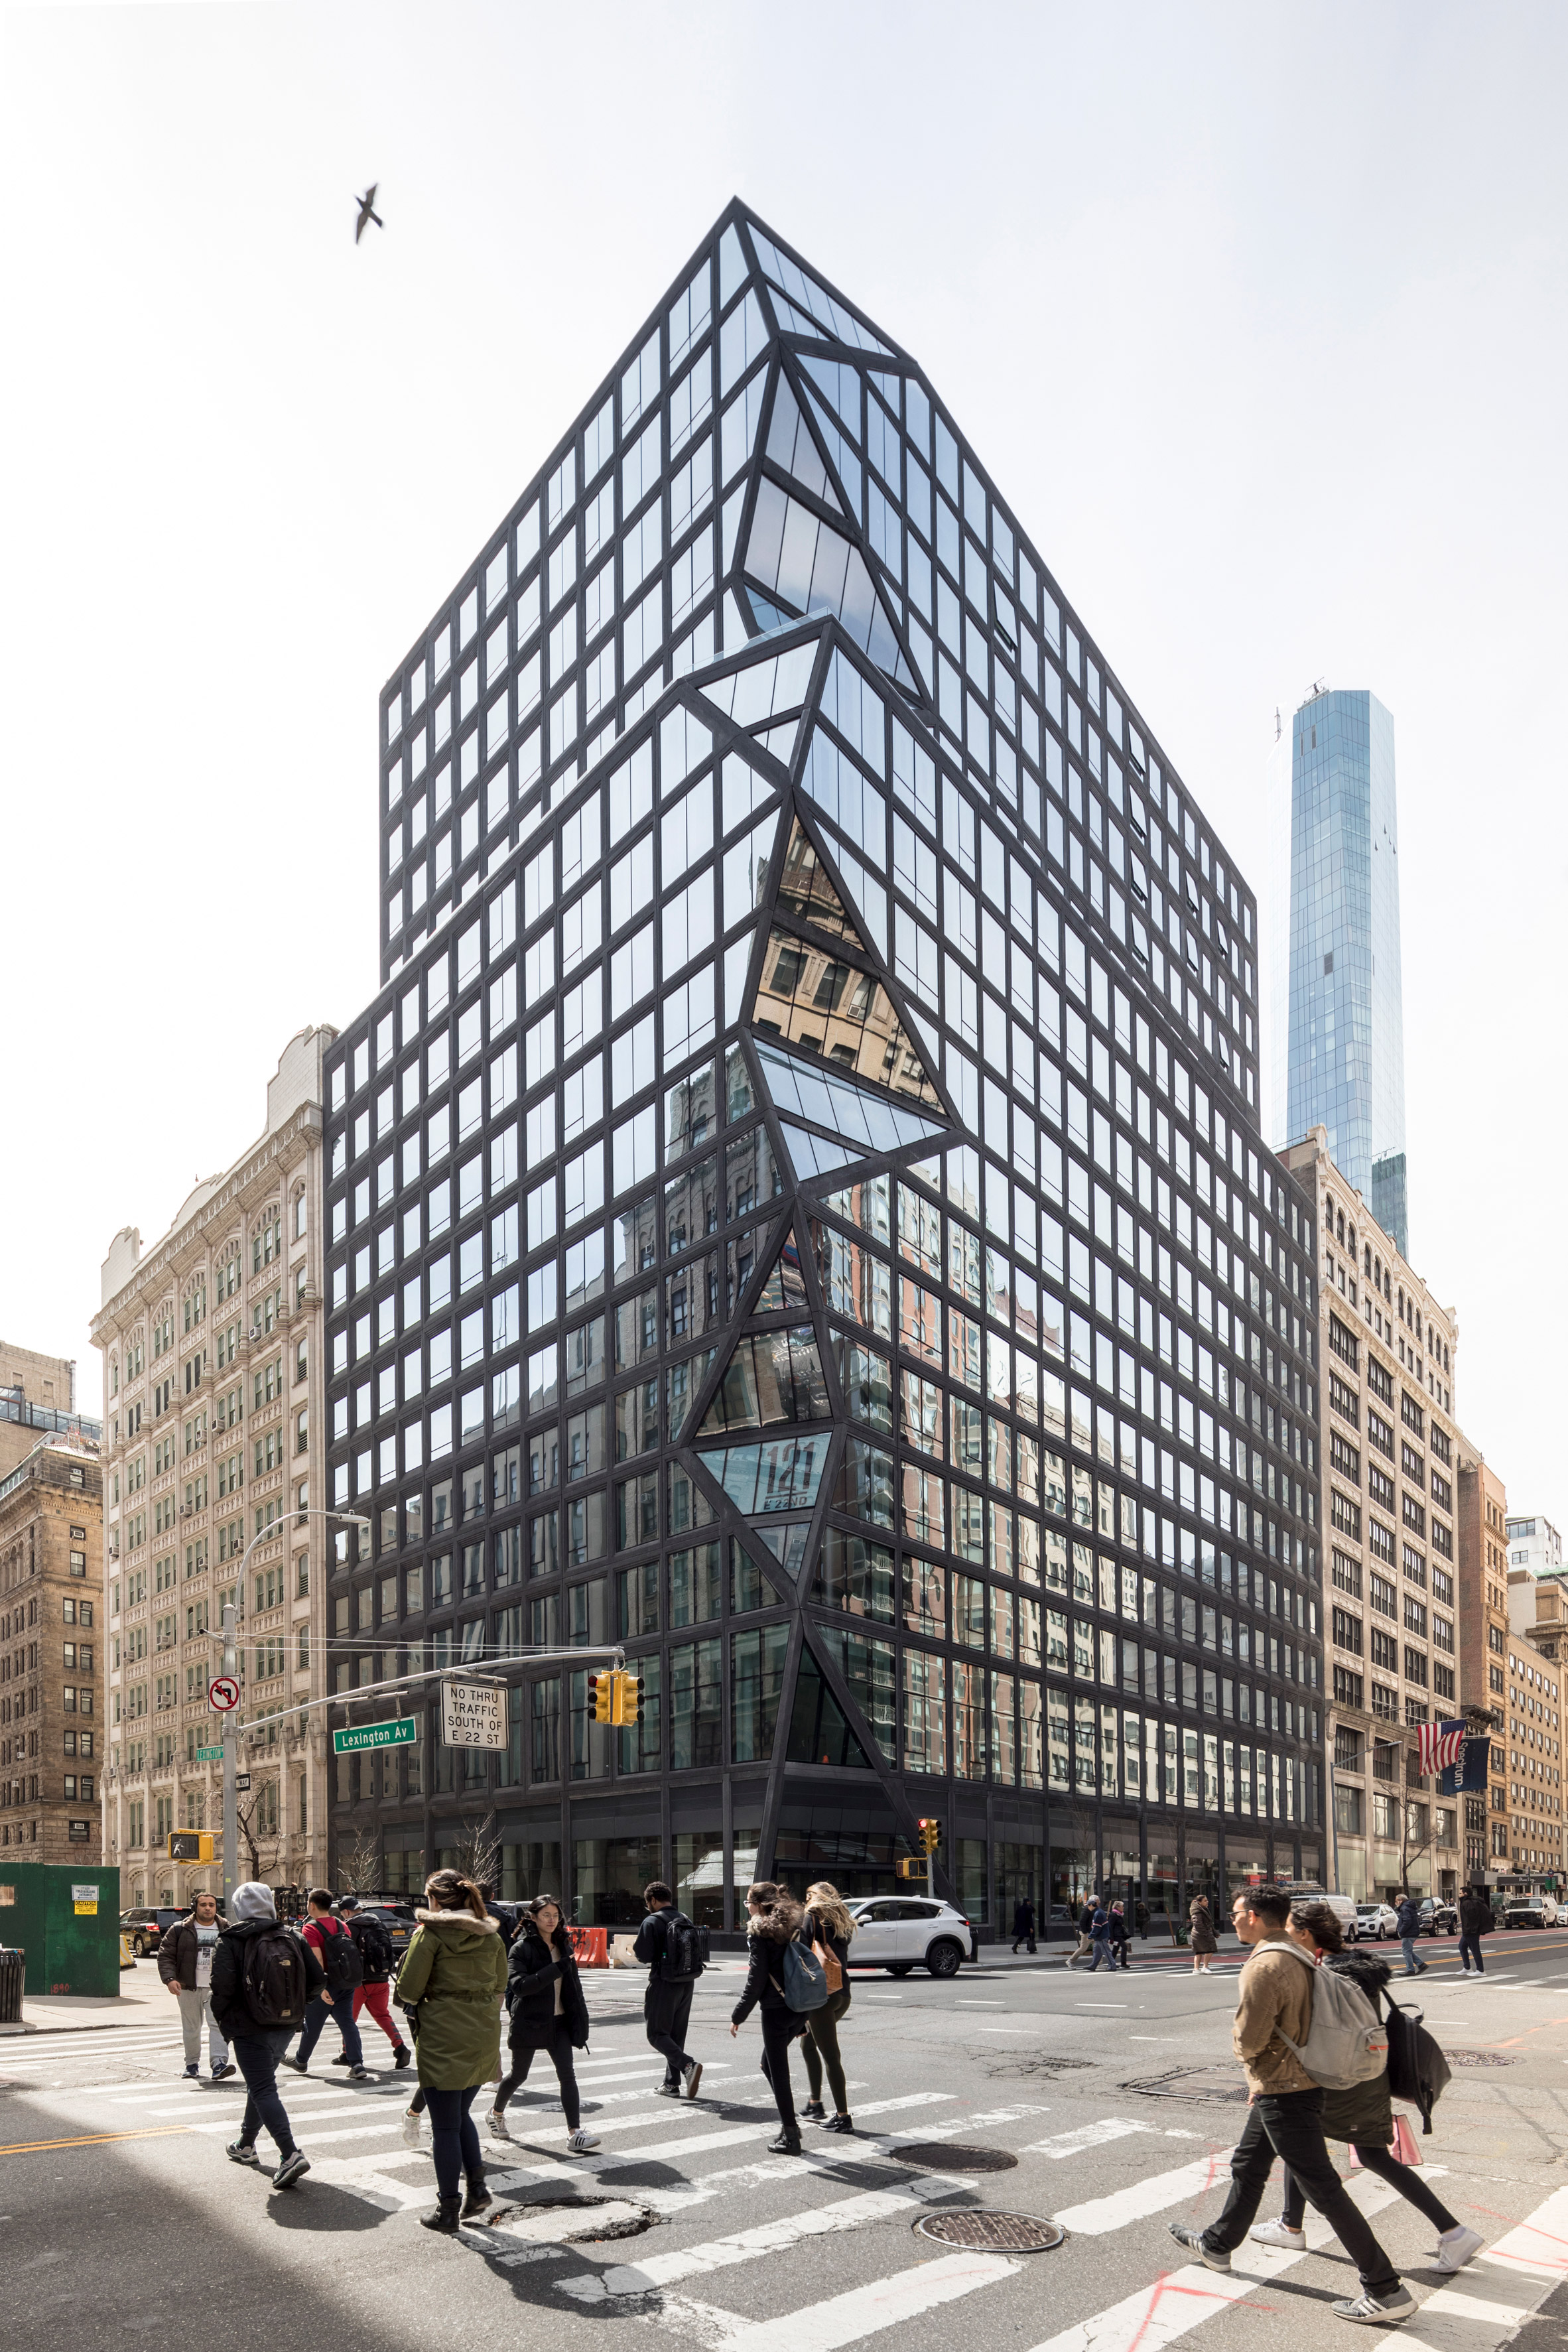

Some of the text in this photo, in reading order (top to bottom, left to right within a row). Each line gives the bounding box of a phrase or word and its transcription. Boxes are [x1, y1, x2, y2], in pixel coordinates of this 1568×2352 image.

[767, 1441, 815, 1494] 121
[763, 1500, 771, 1510] E
[451, 1687, 498, 1703] NO THRU
[452, 1702, 497, 1717] TRAFFIC
[448, 1715, 502, 1731] SOUTH OF
[342, 1726, 407, 1747] Lexington Av
[452, 1730, 499, 1744] E 22 ST
[198, 1748, 221, 1760] LEXINGTON
[1455, 1742, 1468, 1786] Spectrum
[50, 1983, 70, 1995] 1890
